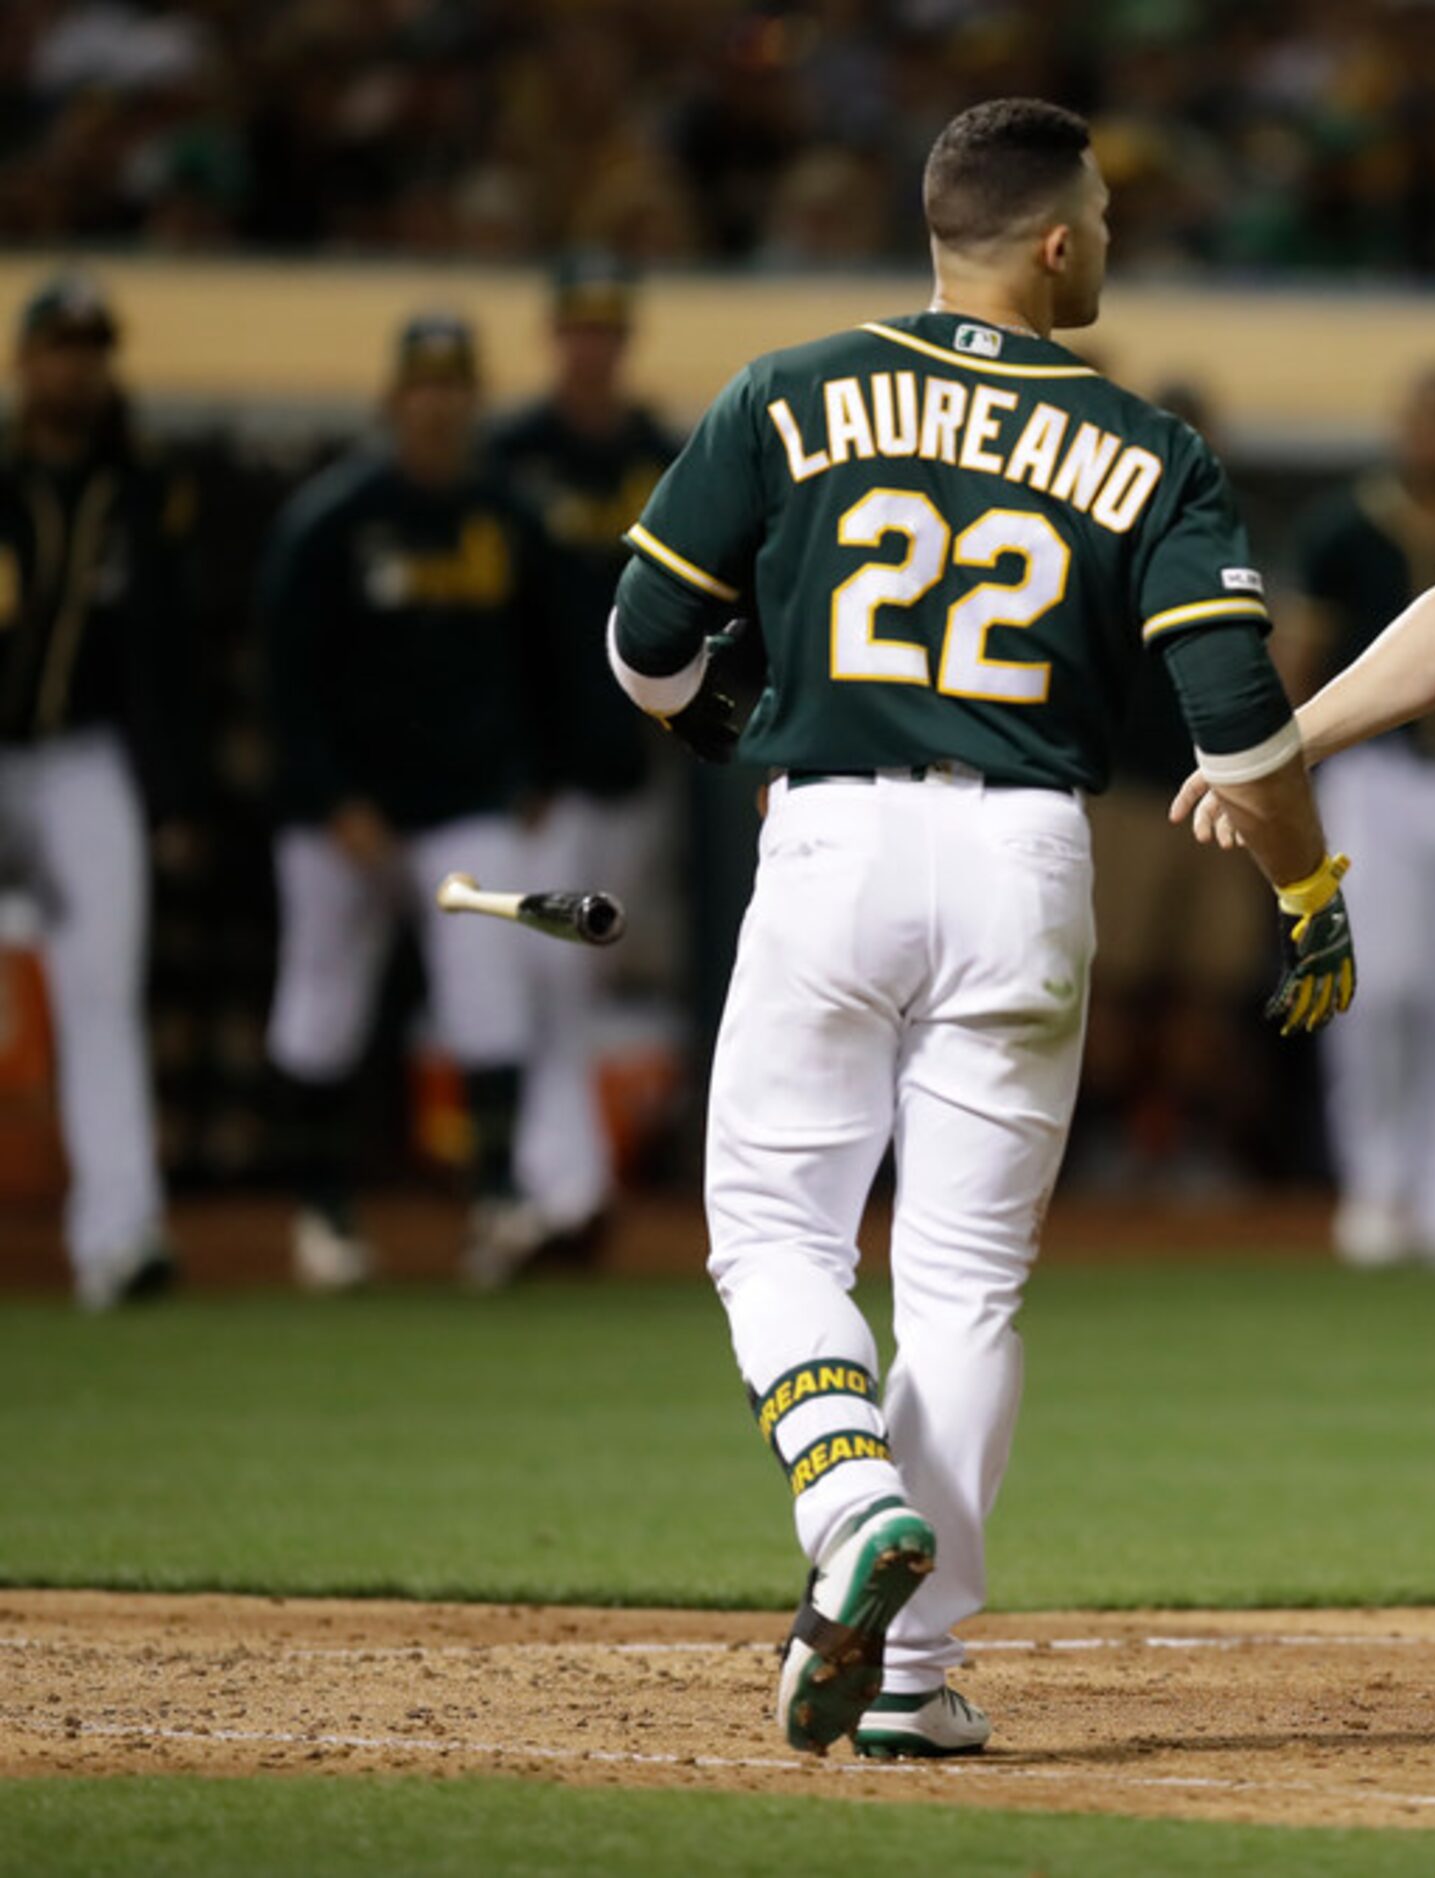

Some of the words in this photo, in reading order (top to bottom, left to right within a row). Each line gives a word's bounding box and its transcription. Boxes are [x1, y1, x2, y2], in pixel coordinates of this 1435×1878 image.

[768, 371, 1163, 533] LAUREANO
[830, 488, 1071, 704] 22
[759, 1367, 867, 1444] REANO
[791, 1436, 891, 1496] REAN
